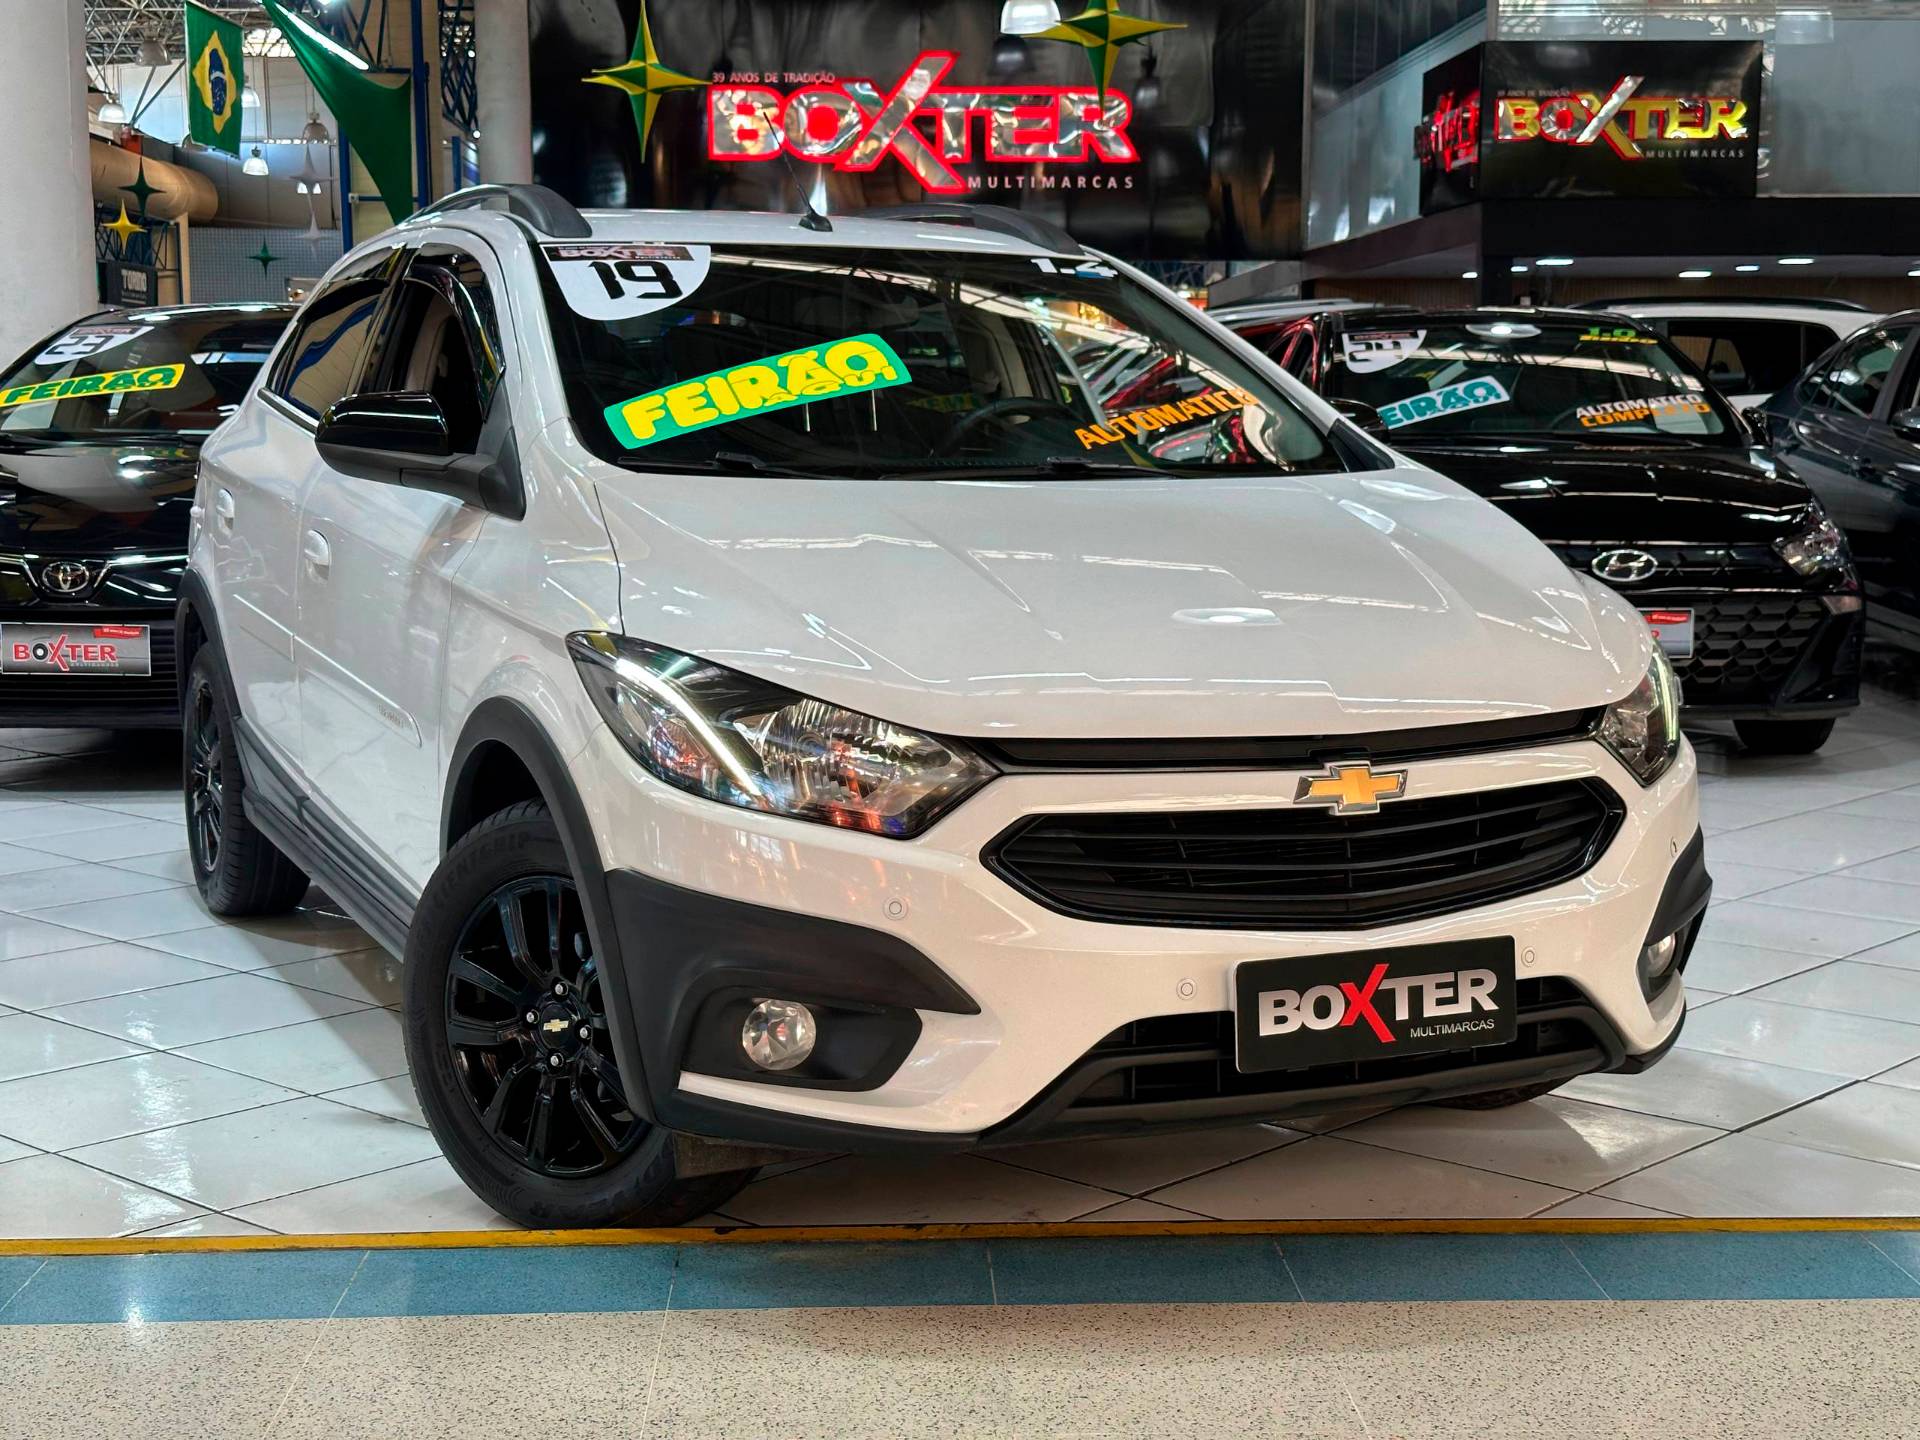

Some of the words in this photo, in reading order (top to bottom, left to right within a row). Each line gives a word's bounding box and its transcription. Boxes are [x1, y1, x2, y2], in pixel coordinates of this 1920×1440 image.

[712, 72, 725, 83] 39
[730, 72, 759, 83] ANOS
[764, 72, 778, 83] DE
[784, 70, 835, 85] TRADIÇÃO
[707, 51, 1139, 194] BOXTER
[1495, 75, 1749, 161] BOXTER
[1646, 149, 1745, 158] MULTIMARCAS
[968, 175, 1134, 189] MULTIMARCAS
[588, 260, 683, 300] 19
[45, 335, 115, 355] 23
[4, 367, 176, 404] FEIRÃO
[622, 341, 890, 440] FEIRÃO
[1379, 381, 1500, 428] EIRÃO
[13, 634, 119, 671] BOXTER
[1258, 963, 1499, 1043] BOXTER
[1410, 1018, 1495, 1038] MULTIMARCAS
